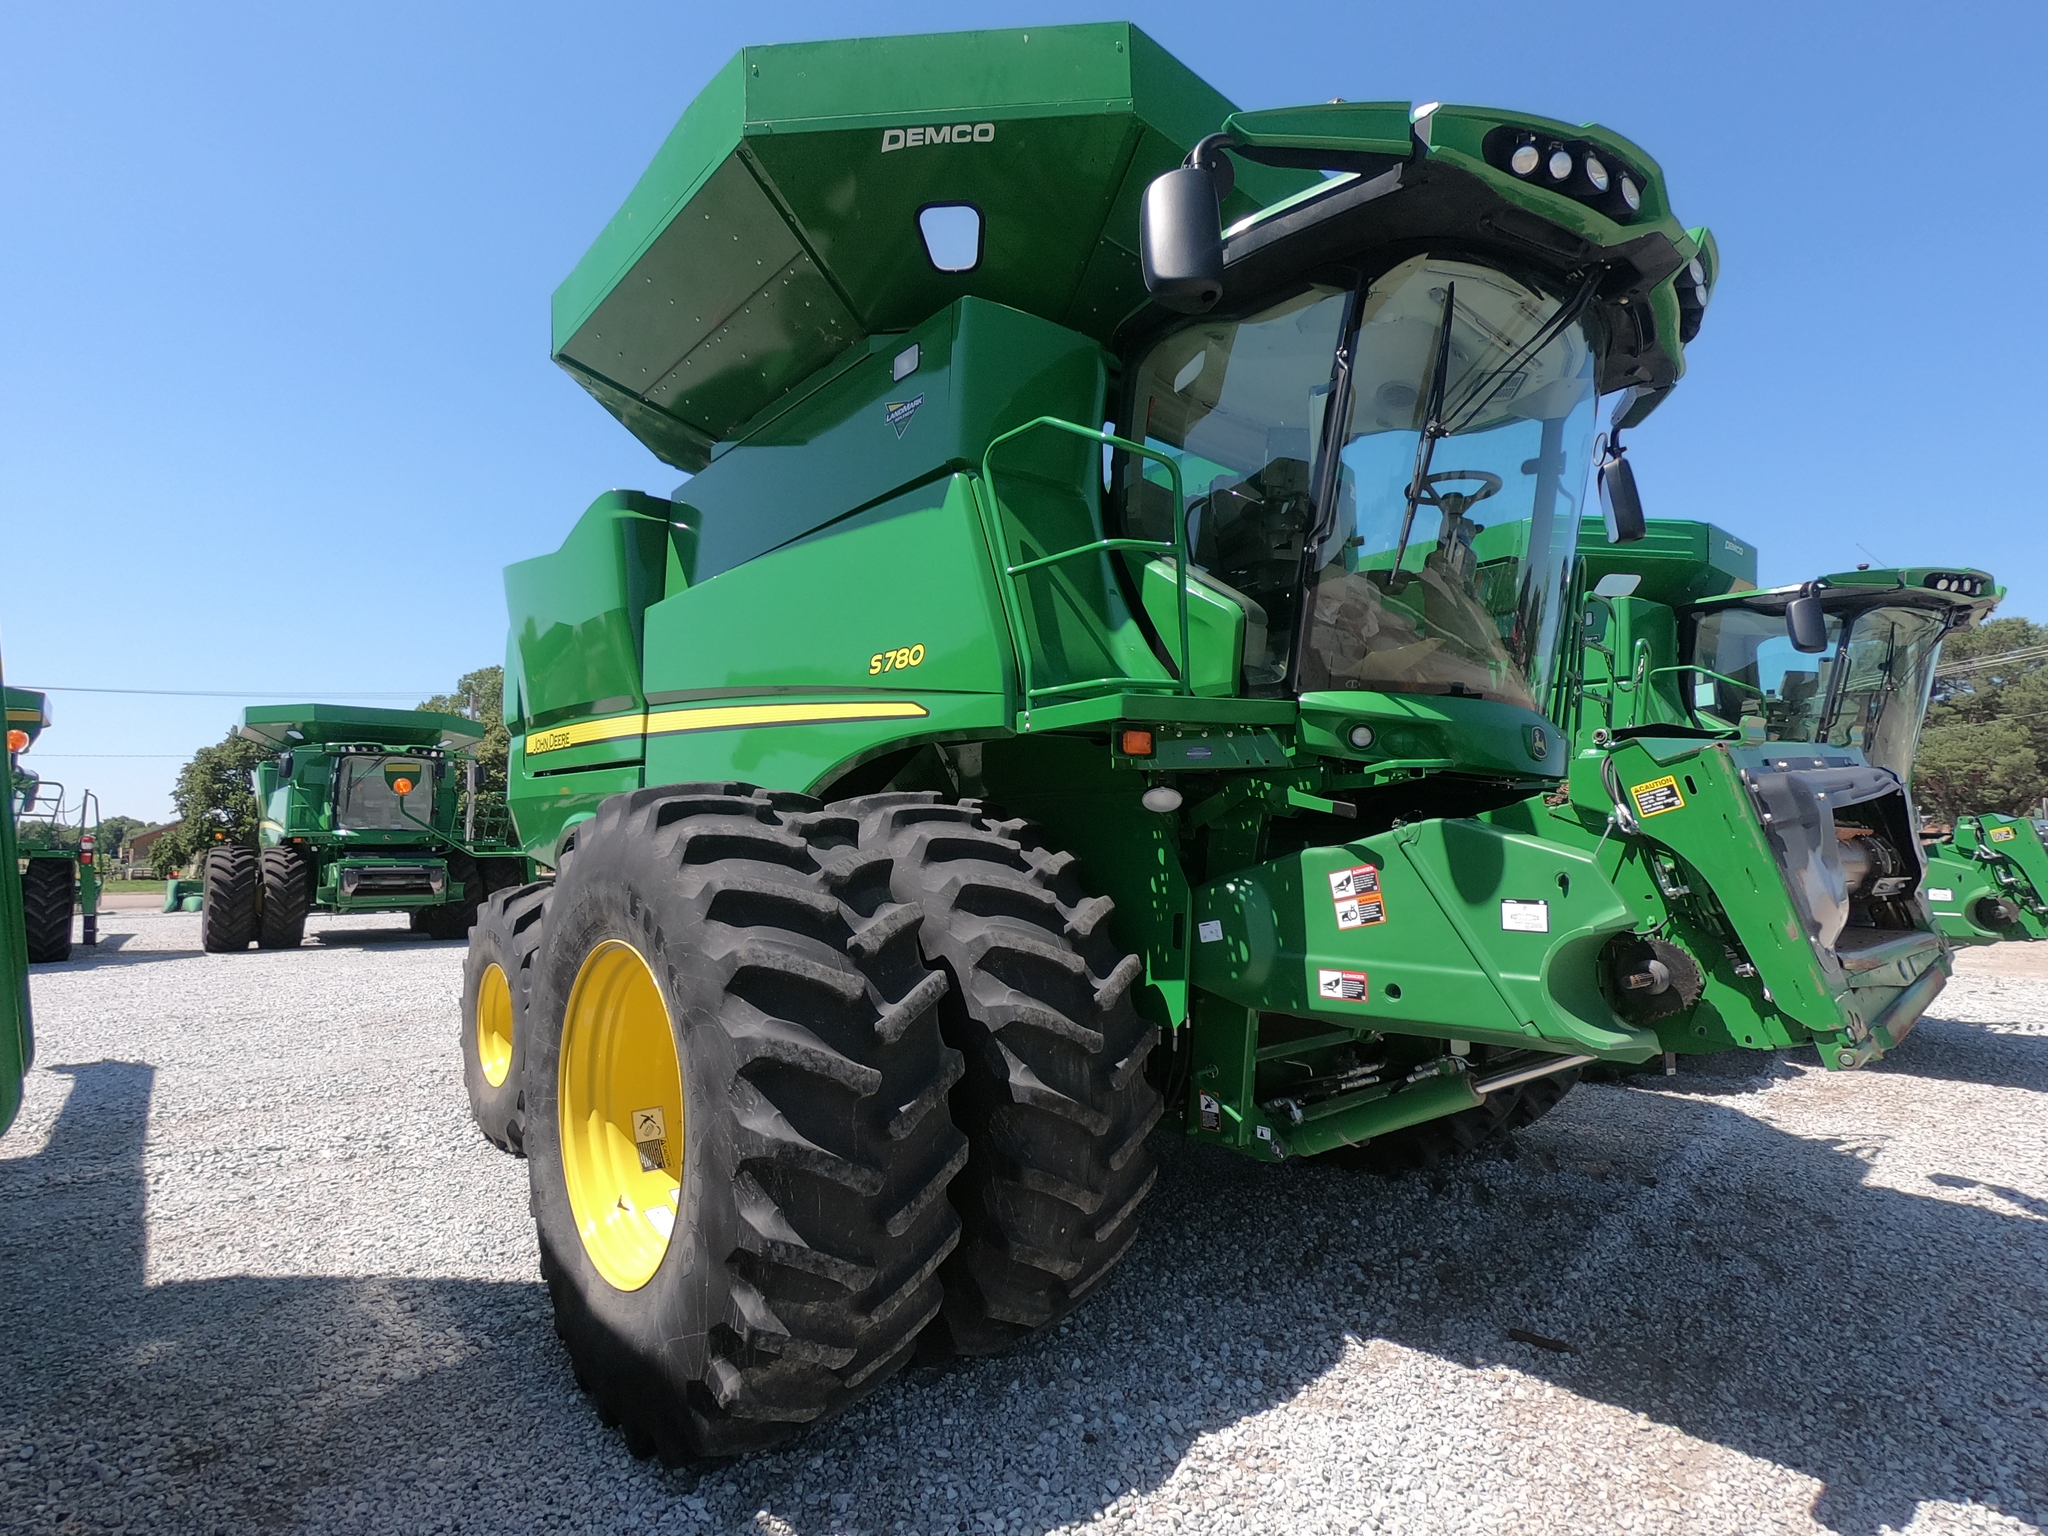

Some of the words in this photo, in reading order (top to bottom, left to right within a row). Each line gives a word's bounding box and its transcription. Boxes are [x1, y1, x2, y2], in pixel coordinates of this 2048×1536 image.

[881, 122, 995, 153] DEMCO
[868, 643, 926, 676] S780
[533, 737, 549, 752] JOHN
[549, 732, 571, 748] DEERE
[1639, 777, 1673, 792] CAUTION
